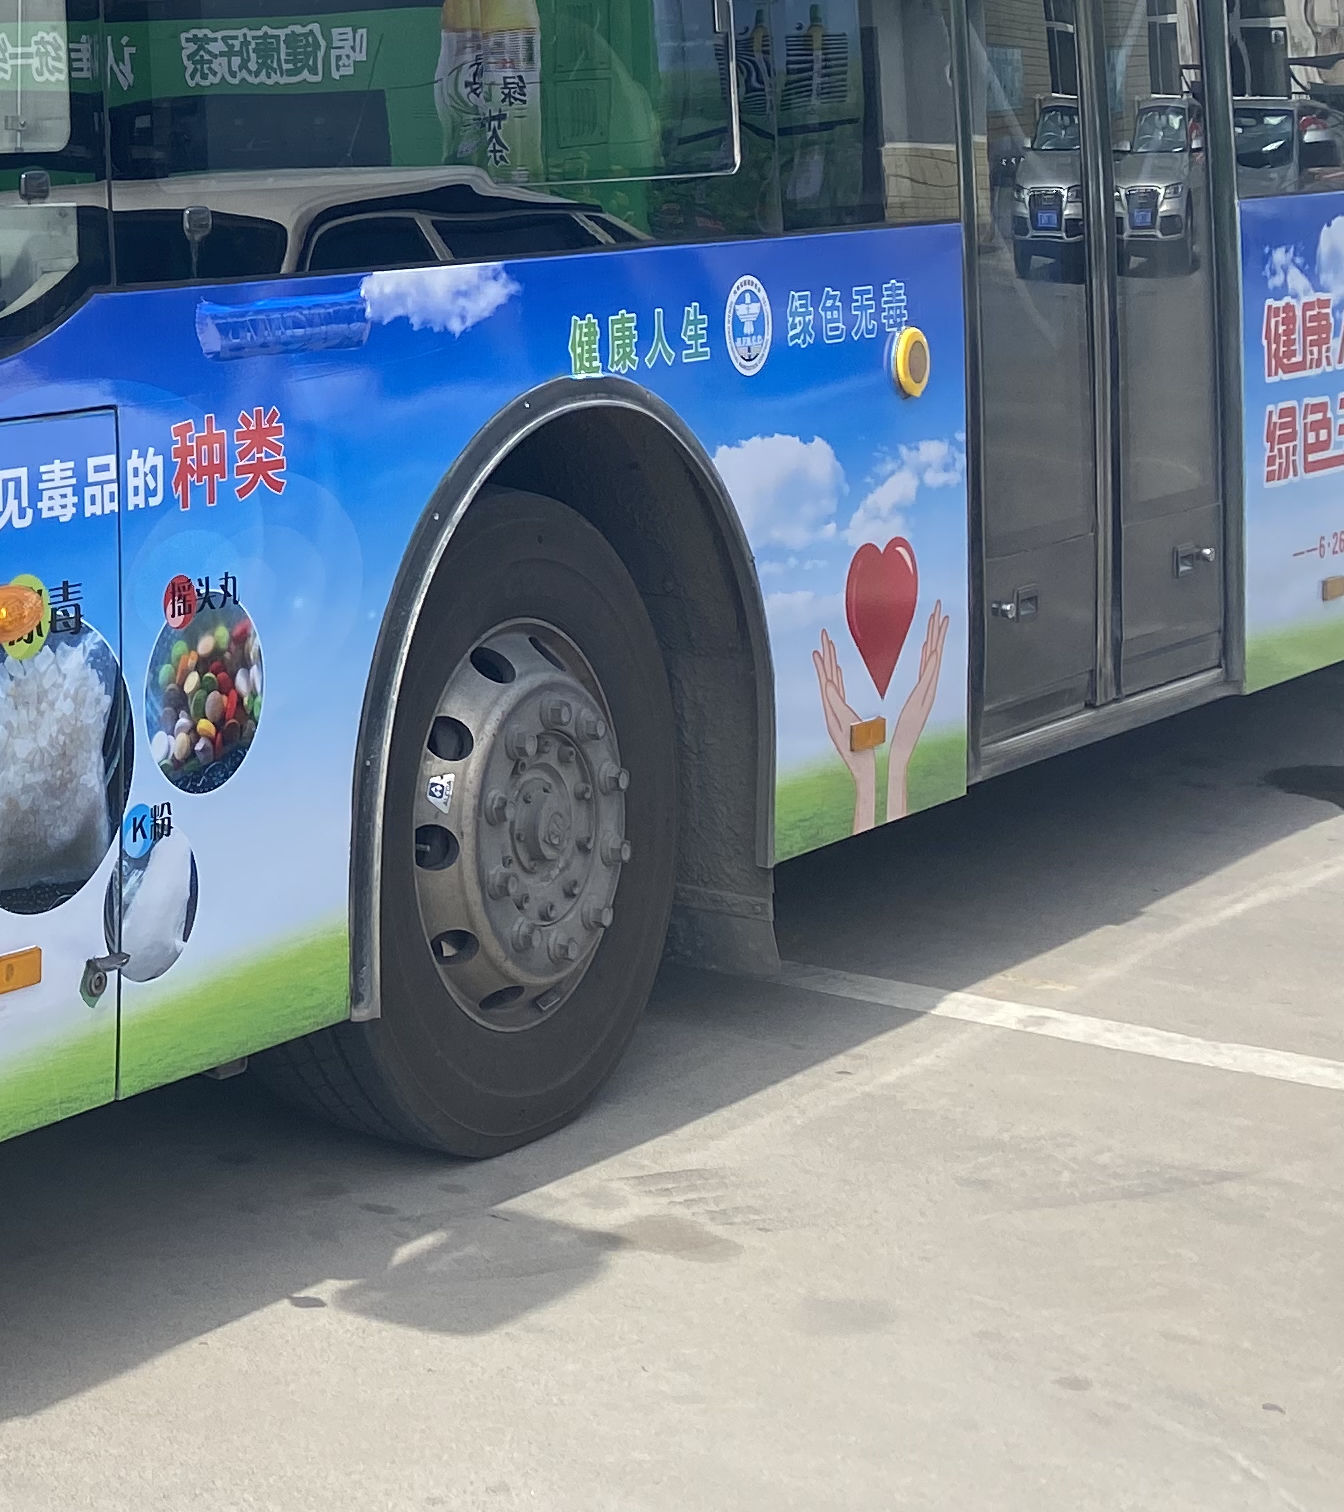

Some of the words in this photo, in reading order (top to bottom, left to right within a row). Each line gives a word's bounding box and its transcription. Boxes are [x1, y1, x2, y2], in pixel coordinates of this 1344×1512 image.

[568, 301, 711, 378] 健康人生
[786, 279, 909, 348] 绿色无毒
[1262, 293, 1344, 383] 健康
[170, 571, 241, 619] 摇头丸
[132, 801, 174, 843] K粉
